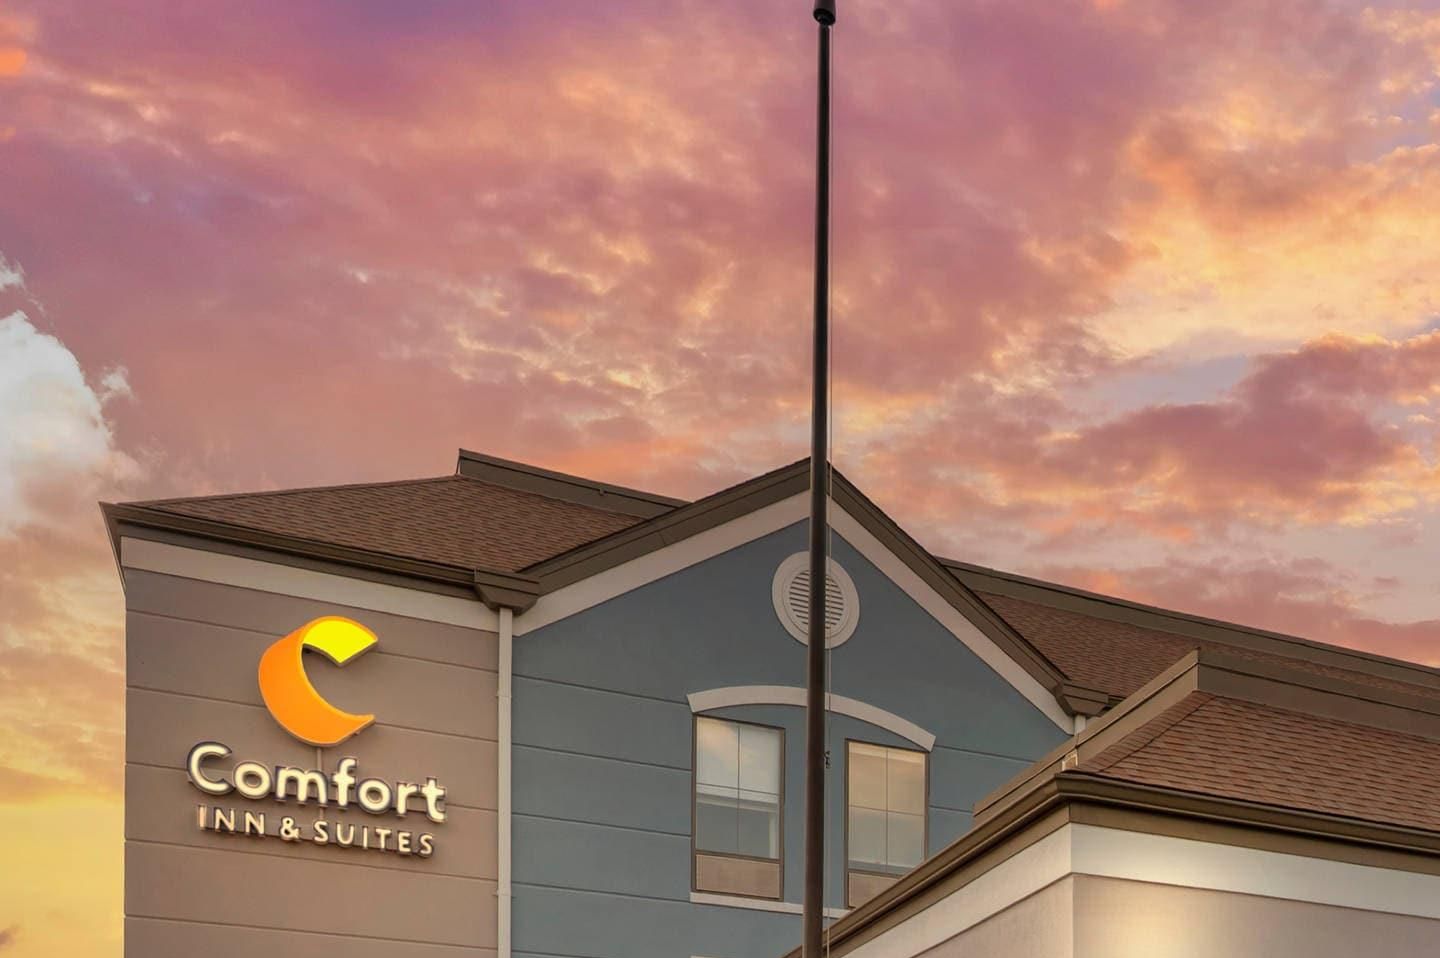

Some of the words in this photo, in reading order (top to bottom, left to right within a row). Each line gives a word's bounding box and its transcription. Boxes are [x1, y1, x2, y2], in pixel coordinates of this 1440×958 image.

[187, 741, 446, 822] Comfort
[197, 804, 266, 837] INN
[279, 816, 300, 841] &
[311, 820, 435, 856] SUITES
